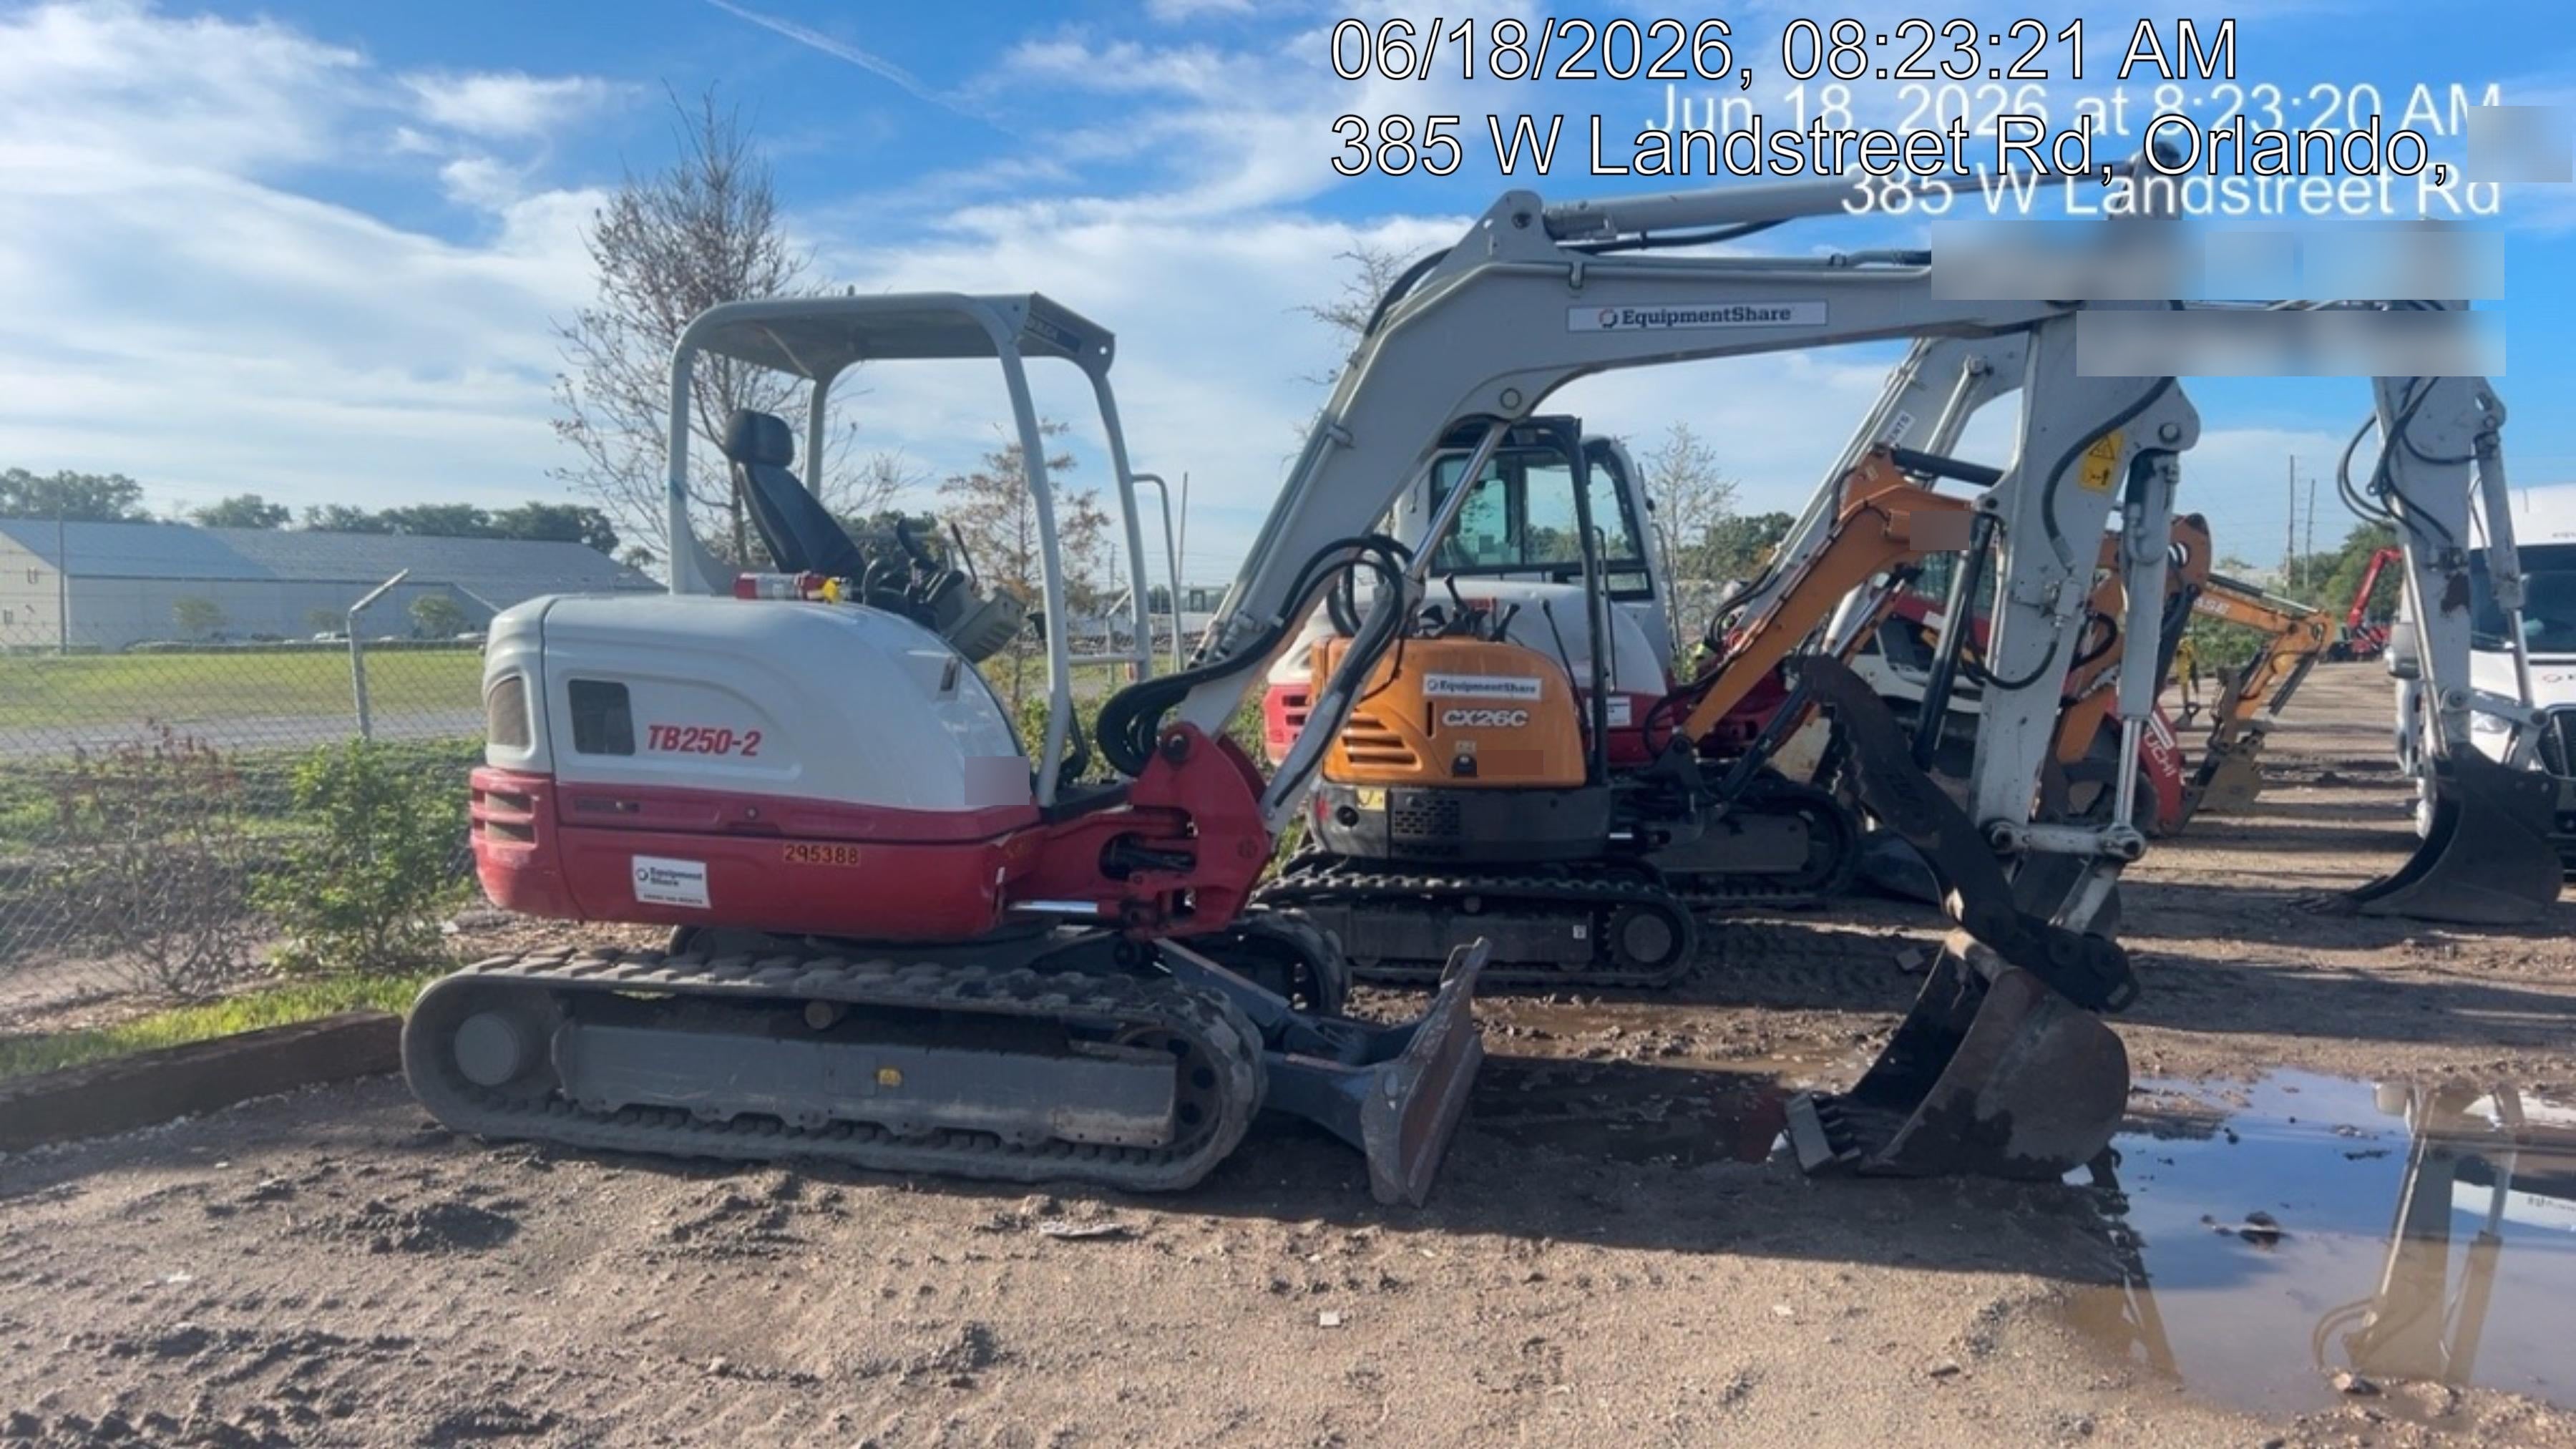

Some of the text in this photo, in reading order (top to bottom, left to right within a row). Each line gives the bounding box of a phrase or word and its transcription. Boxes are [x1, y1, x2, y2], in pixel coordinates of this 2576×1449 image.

[1622, 306, 1792, 326] EquipmentShare
[1439, 680, 1536, 693] EquipmentShare
[1442, 709, 1529, 727] CX26C
[648, 725, 762, 757] TB250-2
[2142, 727, 2177, 778] UCHI
[785, 844, 859, 864] 295388
